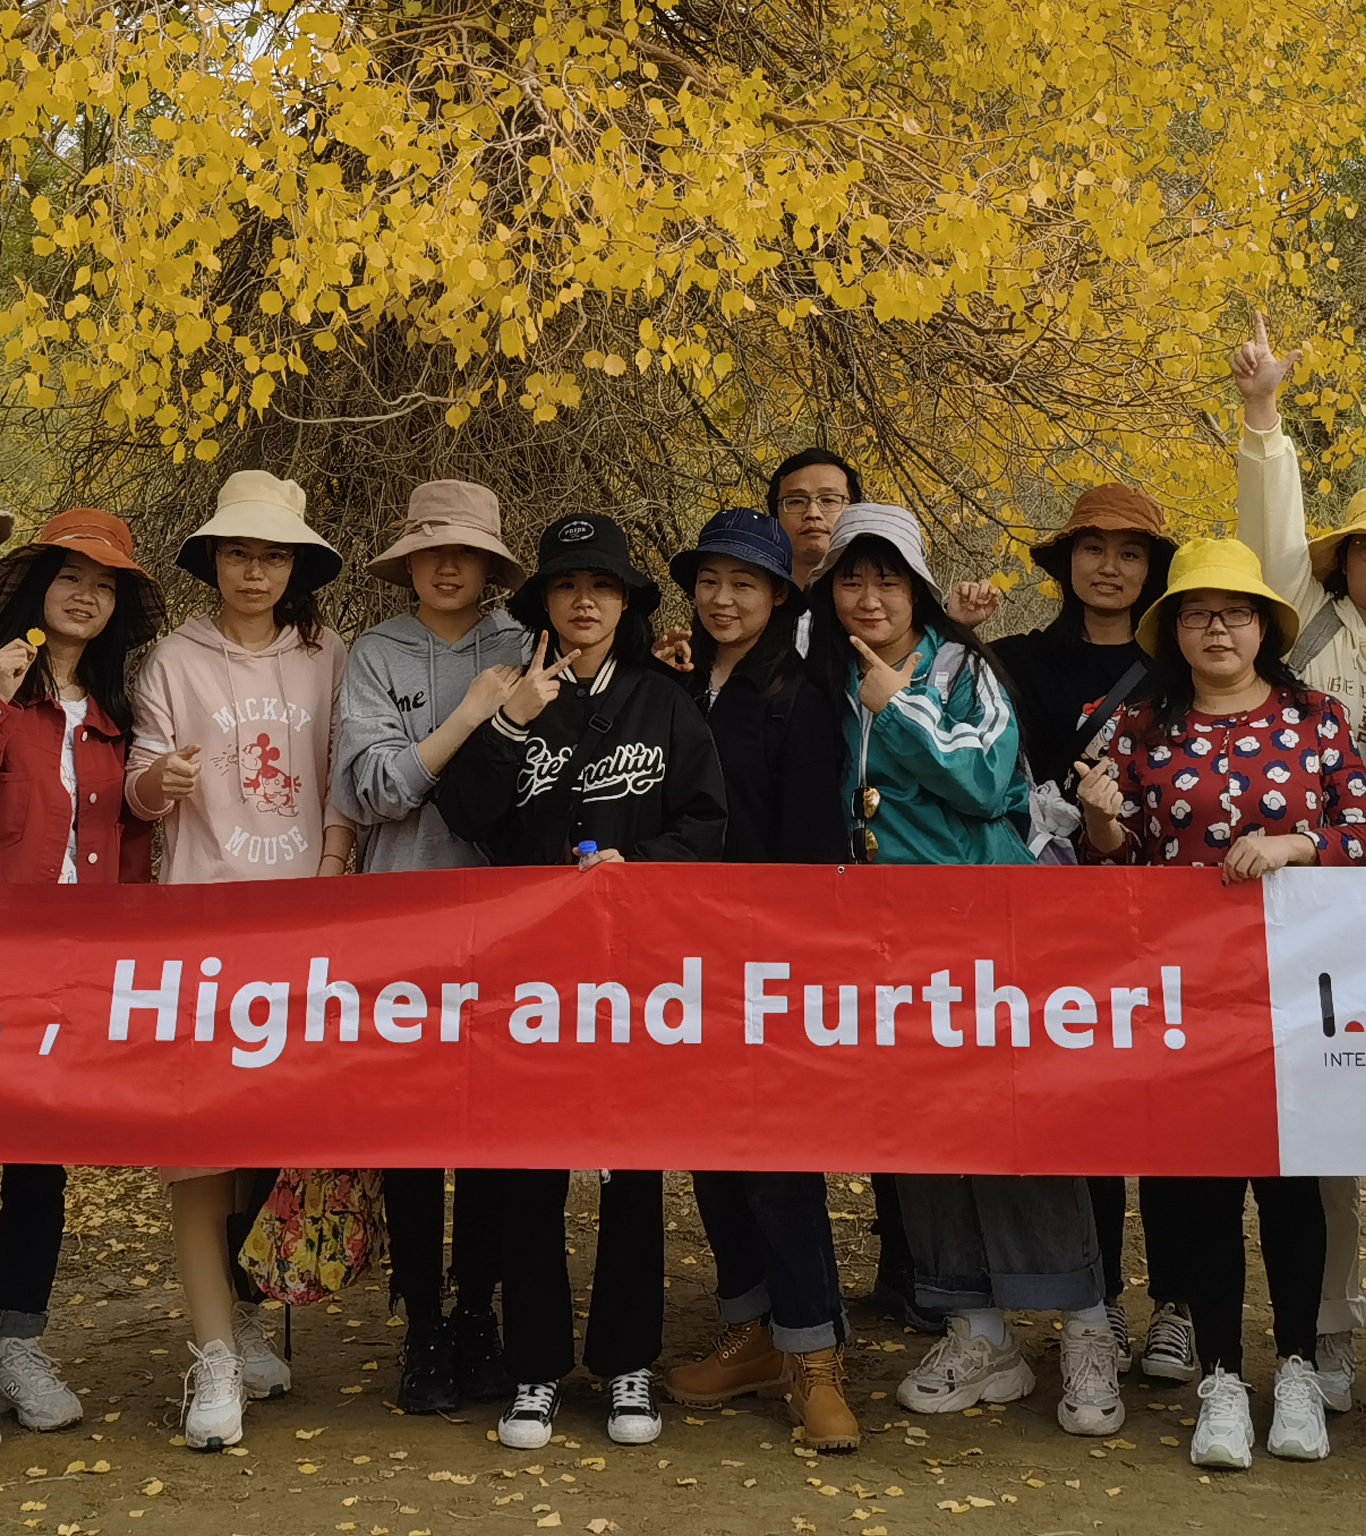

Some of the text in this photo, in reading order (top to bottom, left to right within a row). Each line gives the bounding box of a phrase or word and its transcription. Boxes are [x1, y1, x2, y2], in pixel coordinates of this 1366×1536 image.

[212, 697, 312, 734] MICKEY
[224, 825, 309, 865] MOUSE
[108, 956, 479, 1069] Higher
[508, 956, 703, 1045] and
[744, 959, 1187, 1051] Further!
